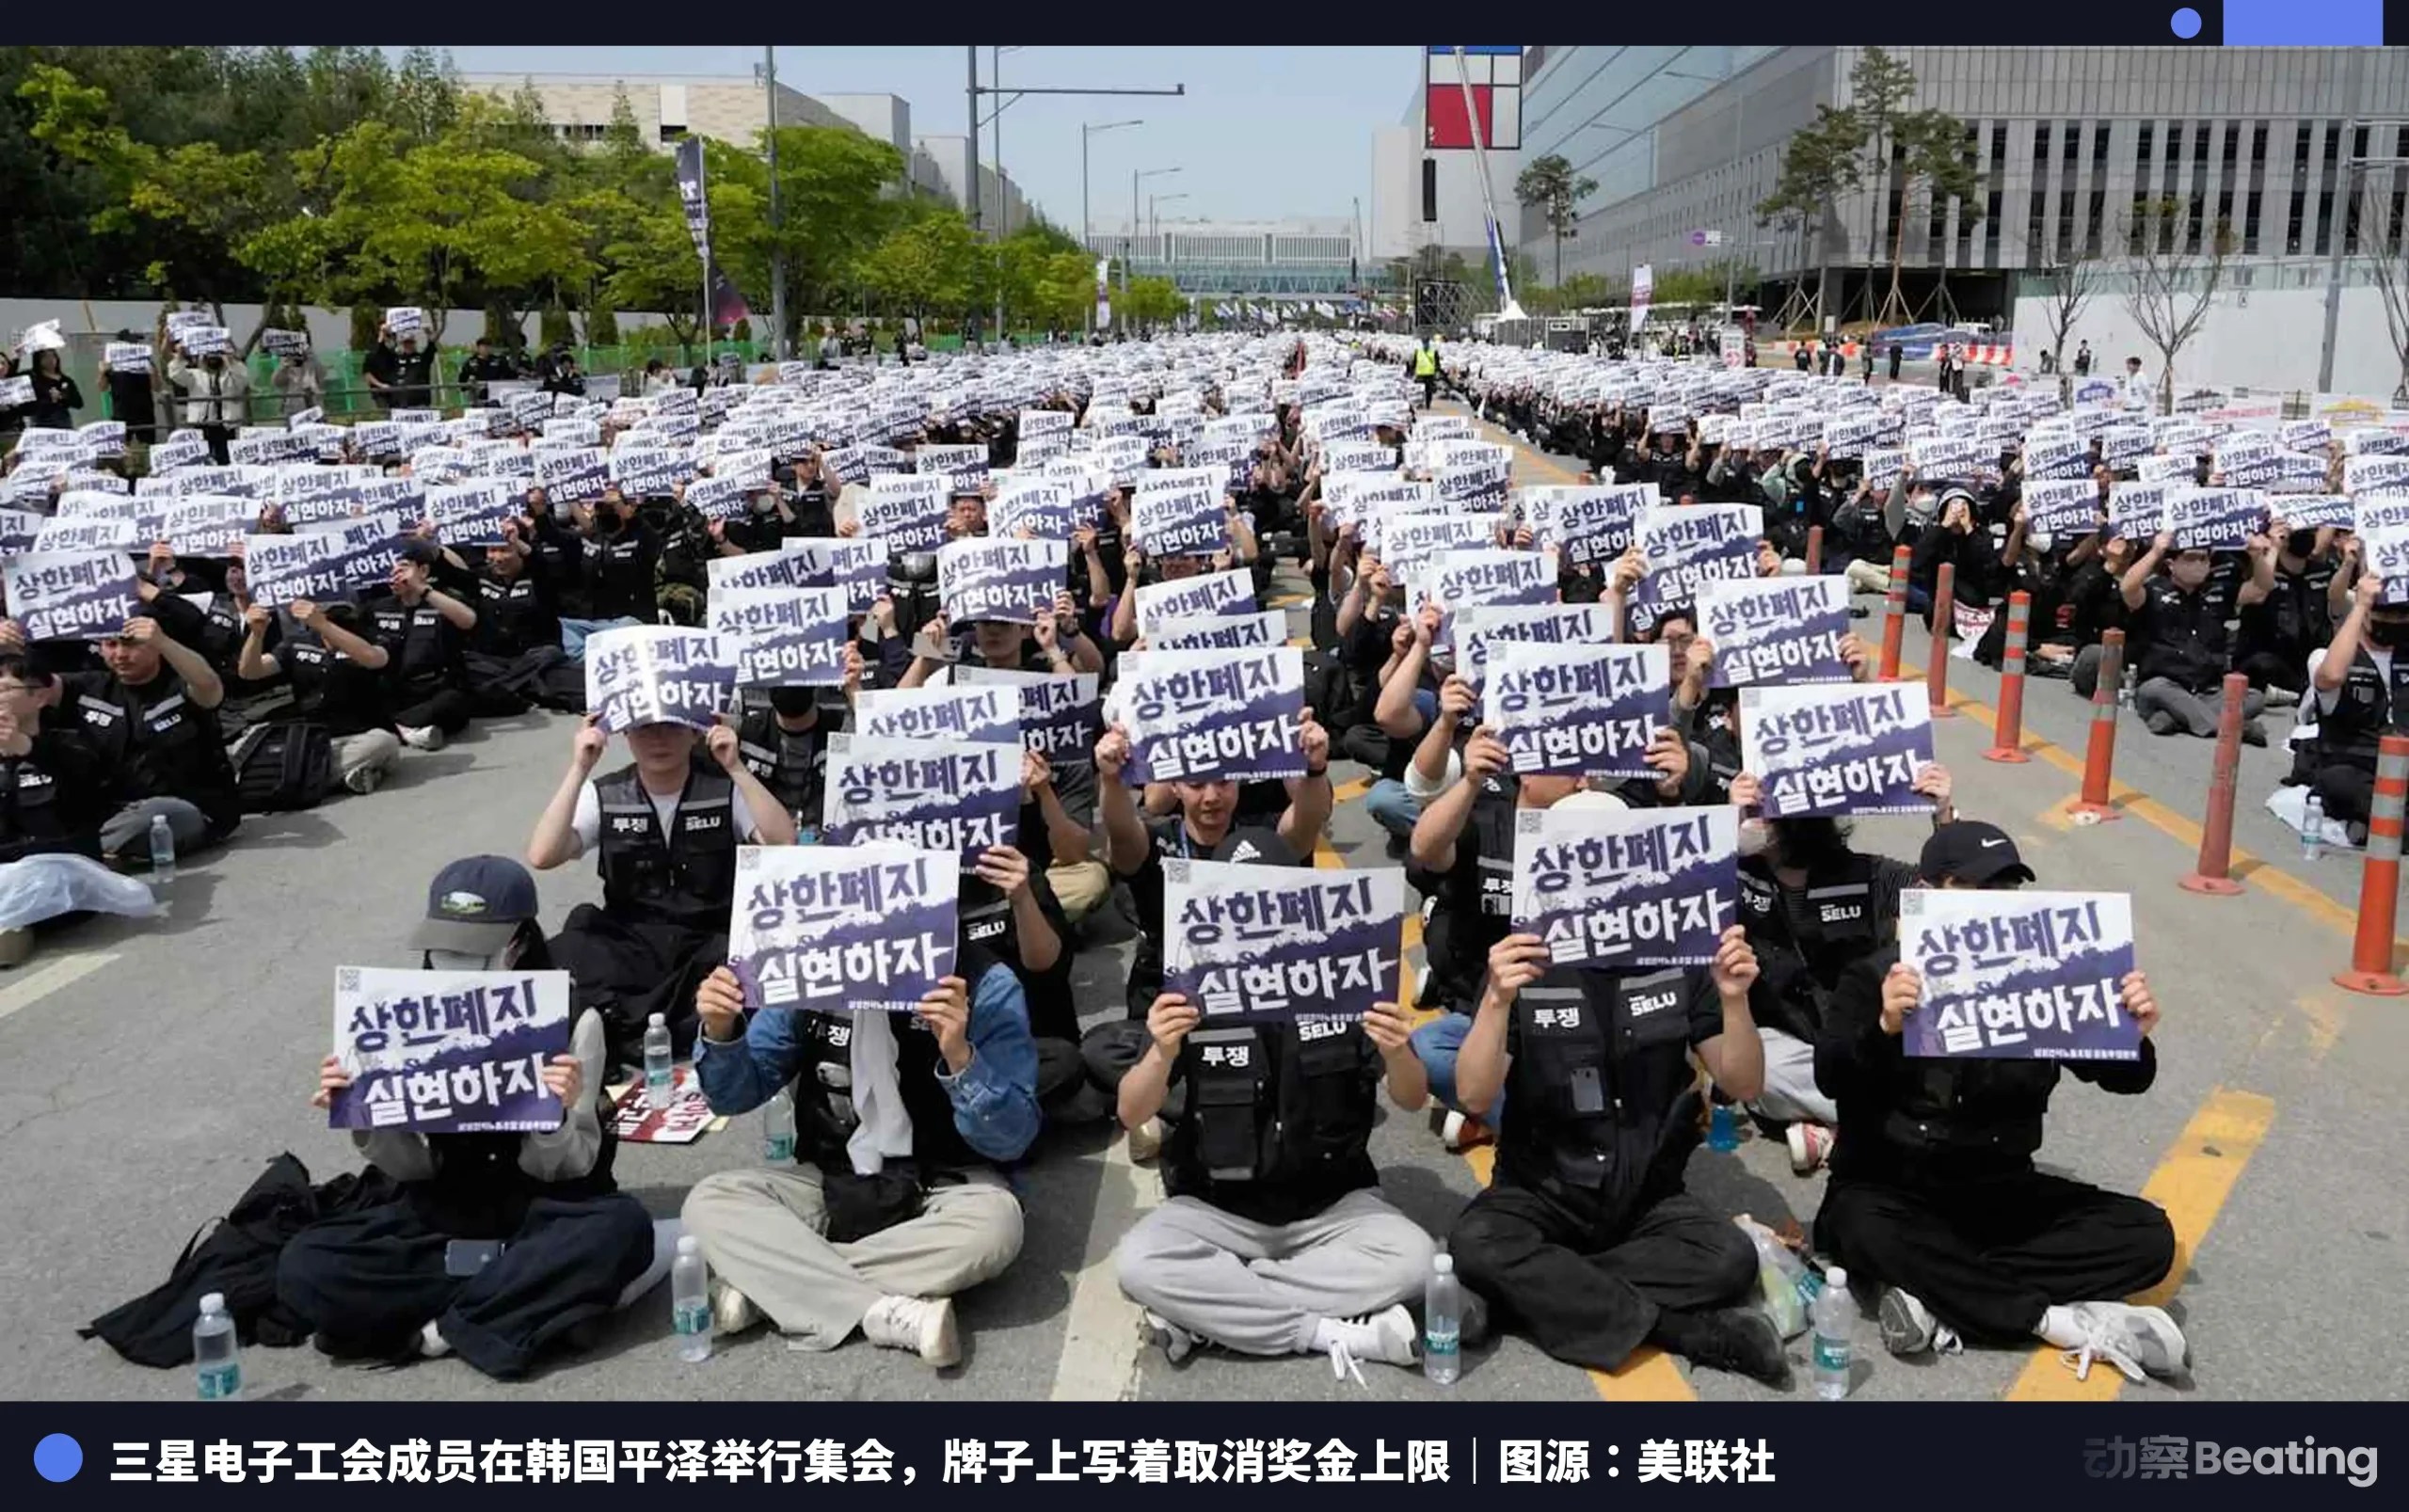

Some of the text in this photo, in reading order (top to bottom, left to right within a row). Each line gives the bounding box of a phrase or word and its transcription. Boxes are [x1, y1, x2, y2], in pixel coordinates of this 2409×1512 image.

[541, 451, 598, 479] 상한폐지
[921, 449, 979, 471] 상한폐지
[431, 490, 496, 517] 상한폐지
[864, 495, 934, 525] 상한폐지
[1139, 490, 1211, 527] 상한폐지
[1559, 487, 1647, 530] 상한폐지
[2170, 492, 2239, 518] 상한폐지
[249, 535, 329, 574] 상한폐지
[1389, 522, 1474, 550] 상한폐지
[1569, 529, 1635, 564] 실현하
[1644, 508, 1748, 559] 상한폐지
[15, 554, 120, 600] 상한폐지
[255, 569, 346, 606] 실현하자
[942, 545, 1030, 584] 상한폐지
[1440, 557, 1542, 600] 상한폐지
[26, 595, 137, 639] 실현하자
[717, 593, 830, 635] 상한폐지
[1708, 581, 1829, 636] 상한폐지
[1722, 630, 1842, 684] 실현하자
[1131, 654, 1280, 720] 상한폐지
[1496, 651, 1646, 712] 상한폐지
[606, 681, 728, 729] 실현하자
[1754, 689, 1906, 756] 상한폐지
[1147, 714, 1300, 779] 실현하자
[1508, 714, 1658, 772] 실현하자
[839, 750, 997, 804] 상한폐지
[1773, 749, 1932, 815] 실현하자
[1529, 814, 1710, 893] 상한폐지
[745, 857, 928, 931] 상한폐지
[1179, 876, 1371, 946] 상한폐지
[1820, 906, 1861, 923] SELU
[968, 921, 1006, 941] SELU
[1544, 888, 1735, 964] 실현하자
[1915, 901, 2102, 978] 상한폐지
[758, 931, 952, 1004] 실현하자
[1198, 947, 1398, 1015] 실현하자
[348, 978, 537, 1052] 상한폐지
[1534, 1008, 1580, 1029] 투쟁
[1630, 993, 1677, 1017] SELU
[1937, 978, 2122, 1053] 실현하자
[1299, 1021, 1348, 1042] SELU
[1202, 1046, 1249, 1067] 투쟁
[365, 1052, 547, 1126] 실현하자
